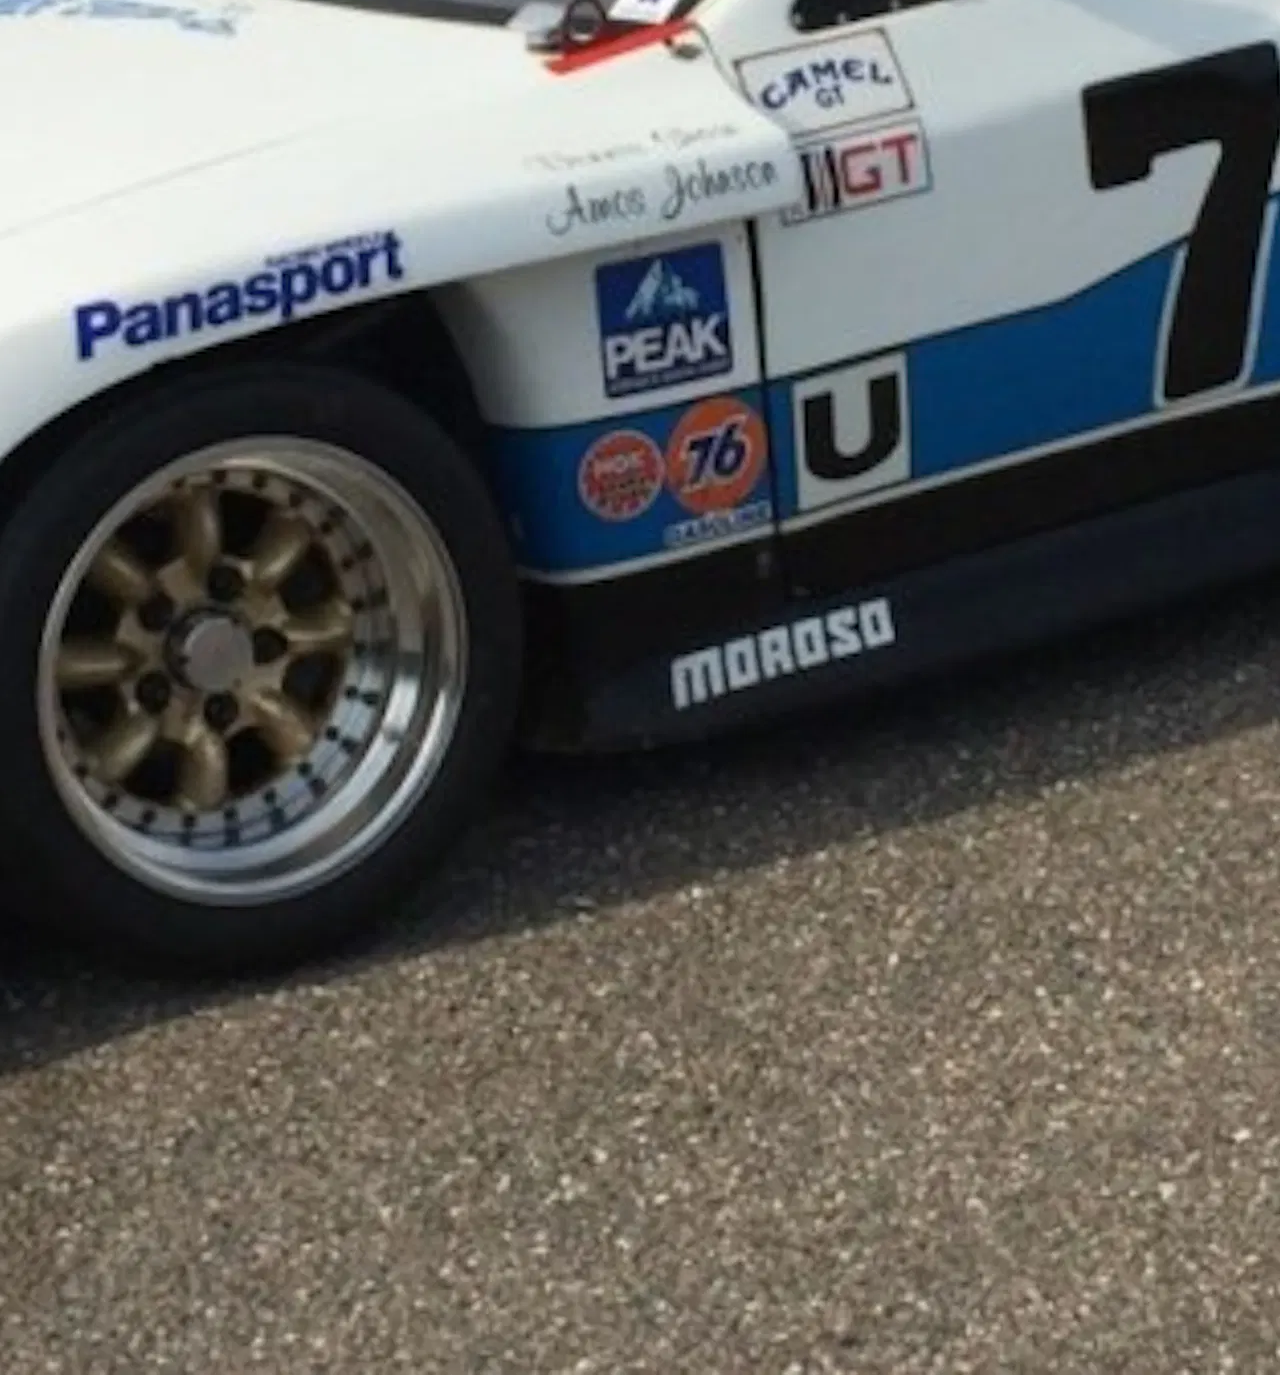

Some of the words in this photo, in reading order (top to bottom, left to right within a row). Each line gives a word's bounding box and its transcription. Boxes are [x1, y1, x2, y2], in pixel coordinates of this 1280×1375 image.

[761, 57, 893, 111] CAMEL
[815, 83, 845, 109] GT
[840, 132, 918, 197] GT
[74, 228, 403, 360] Panasport
[605, 313, 728, 381] PEAK
[684, 414, 752, 493] 76
[803, 371, 901, 480] U
[670, 597, 898, 711] MOROSO
